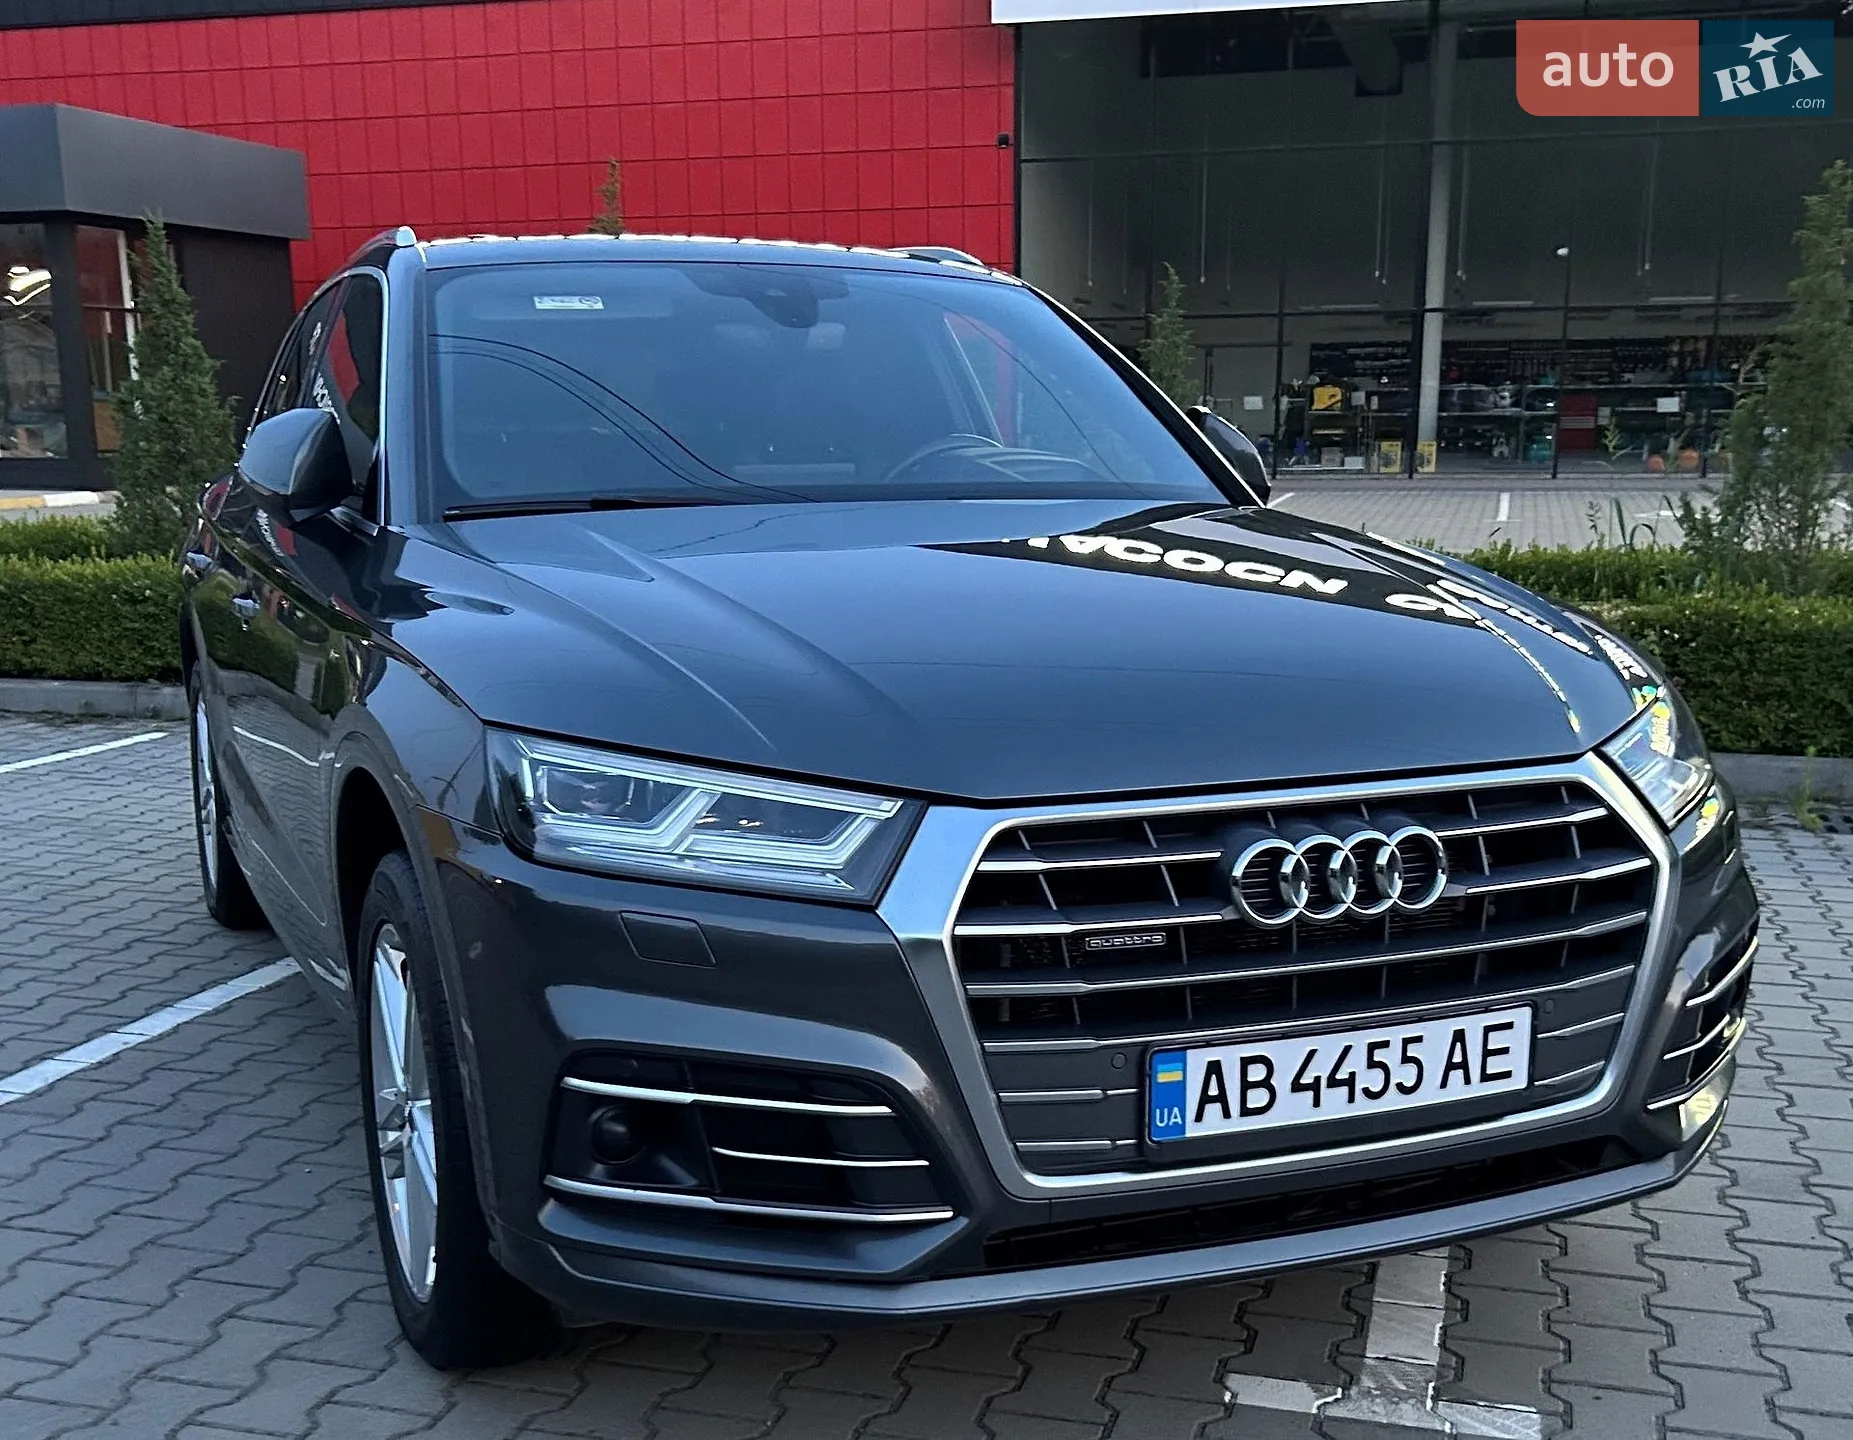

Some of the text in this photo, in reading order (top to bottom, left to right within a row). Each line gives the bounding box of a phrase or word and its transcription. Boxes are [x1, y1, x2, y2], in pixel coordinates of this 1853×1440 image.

[1090, 935, 1162, 948] quattro
[1194, 1021, 1515, 1124] AB 4455 AE
[1155, 1107, 1183, 1128] UA
